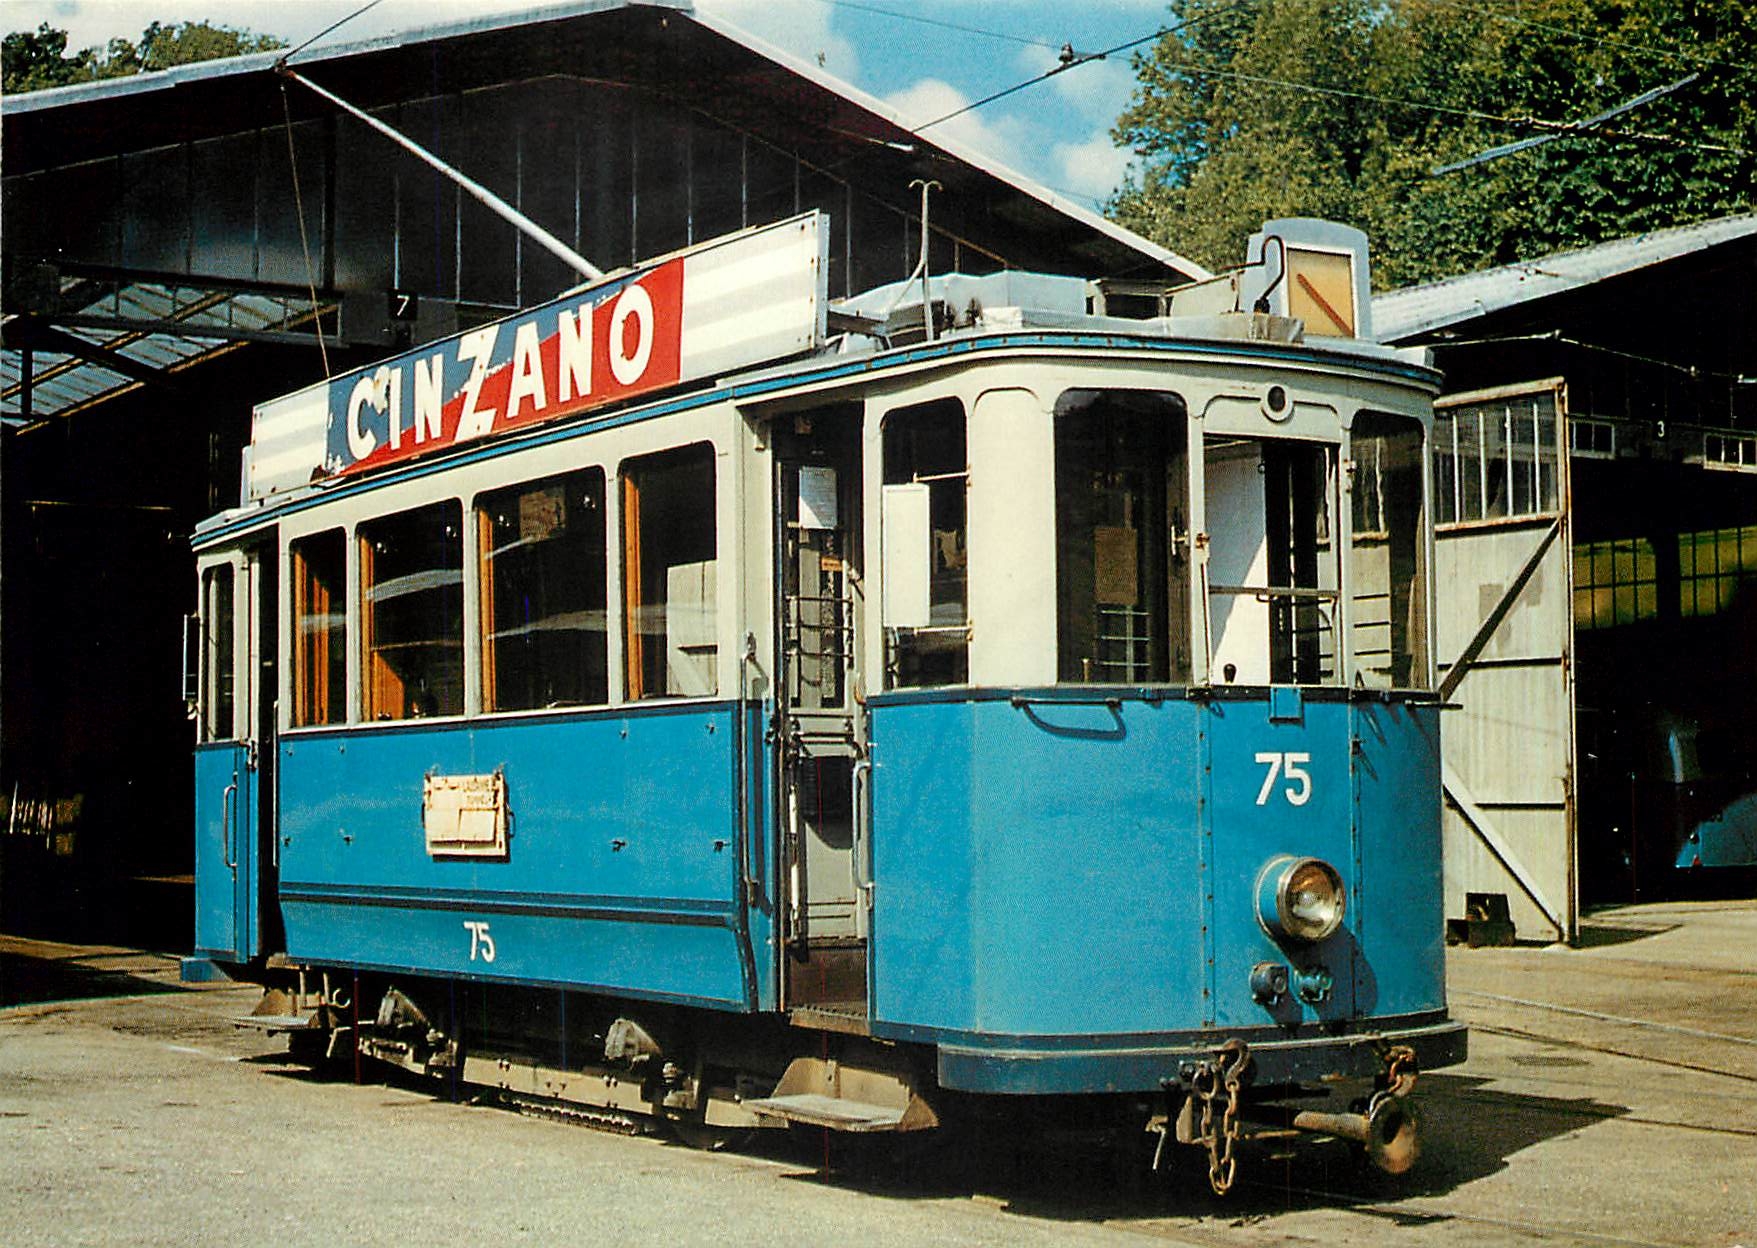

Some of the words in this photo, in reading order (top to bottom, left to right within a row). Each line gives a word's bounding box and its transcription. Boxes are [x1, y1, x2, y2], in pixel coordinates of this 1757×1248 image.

[397, 295, 409, 316] 7
[347, 284, 653, 460] CINZANO
[1657, 420, 1665, 437] 3
[1255, 752, 1311, 806] 75
[463, 921, 496, 963] 75
